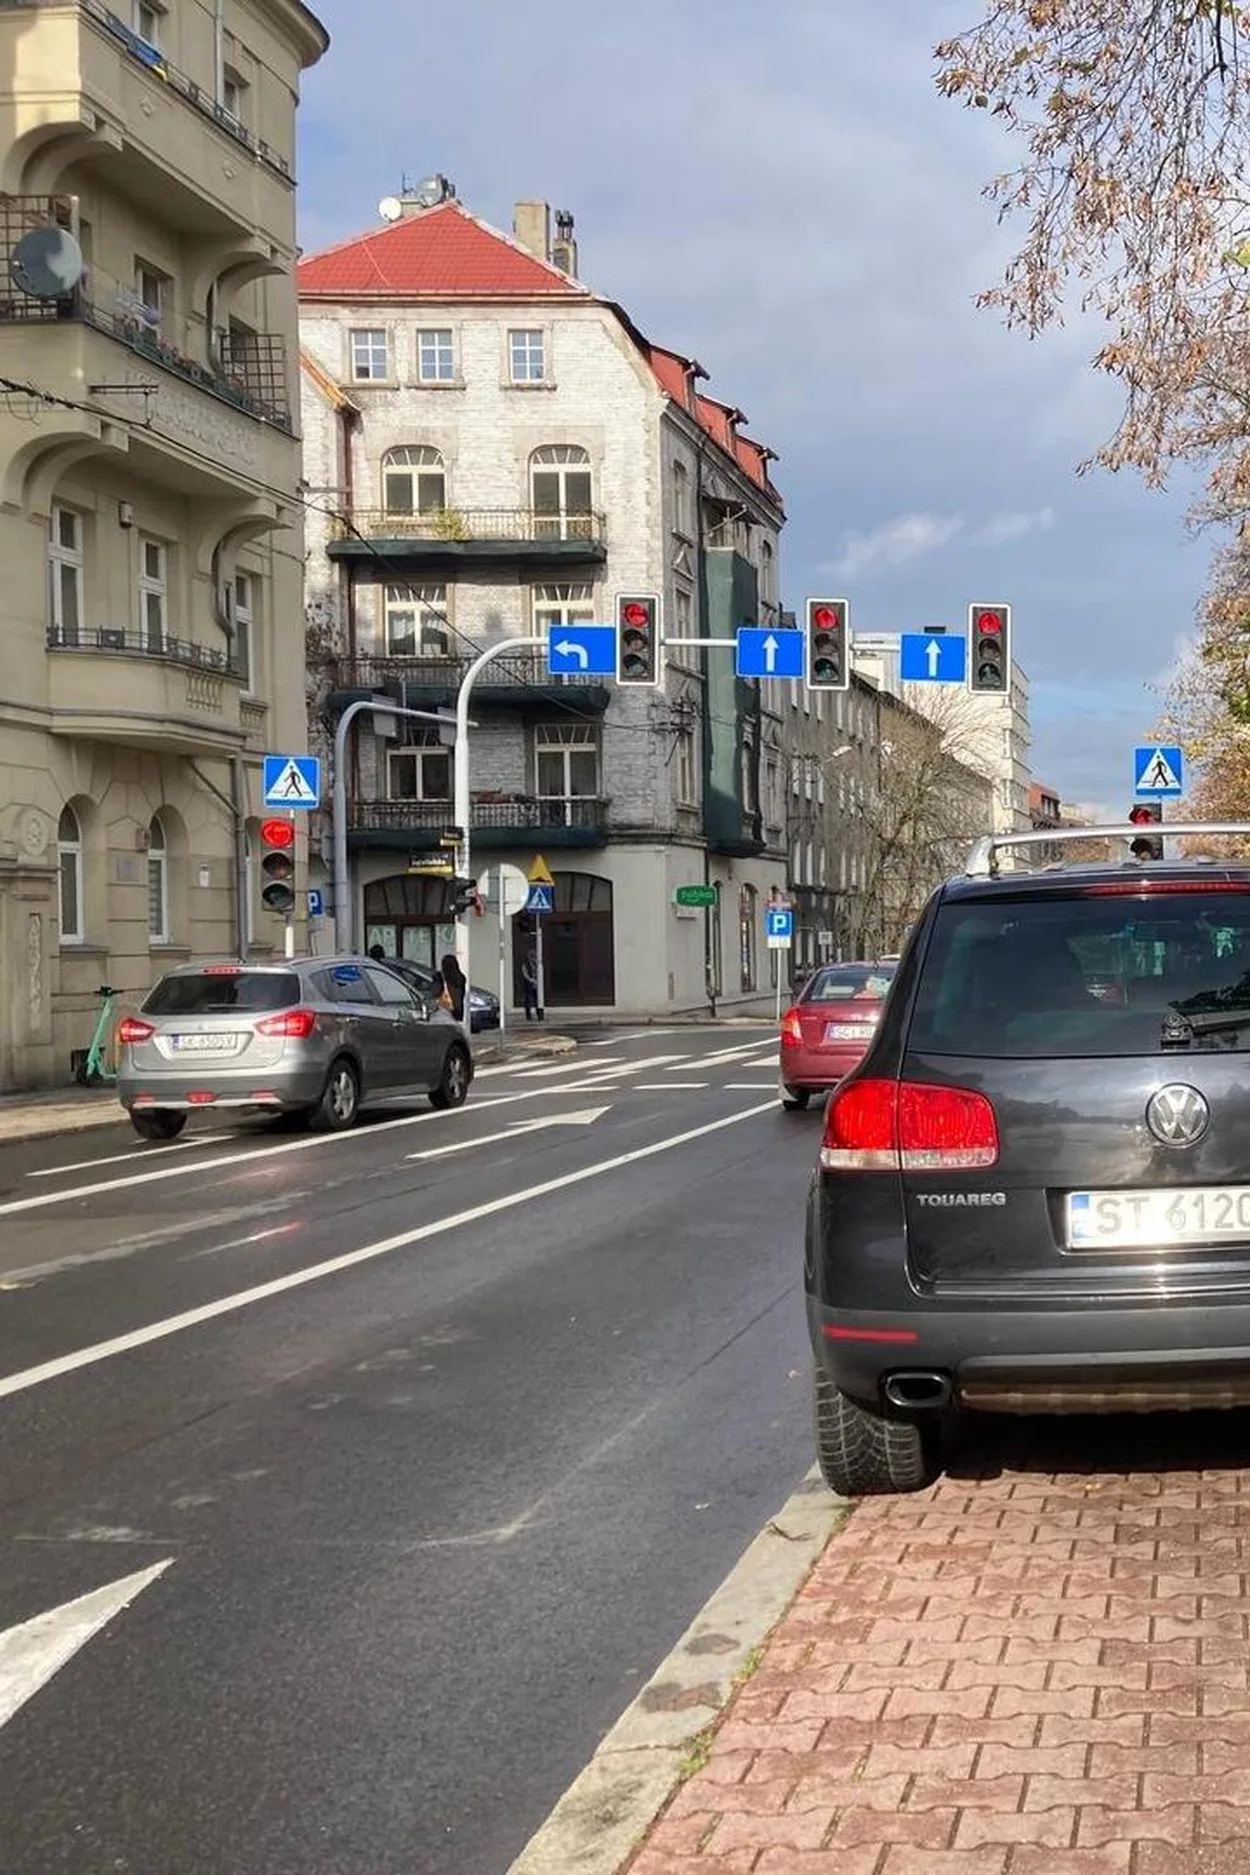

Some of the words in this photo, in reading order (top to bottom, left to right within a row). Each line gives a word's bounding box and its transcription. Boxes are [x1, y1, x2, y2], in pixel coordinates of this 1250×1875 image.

[773, 915, 787, 933] P
[916, 1192, 1006, 1207] TOUAREG
[1096, 1196, 1150, 1236] ST
